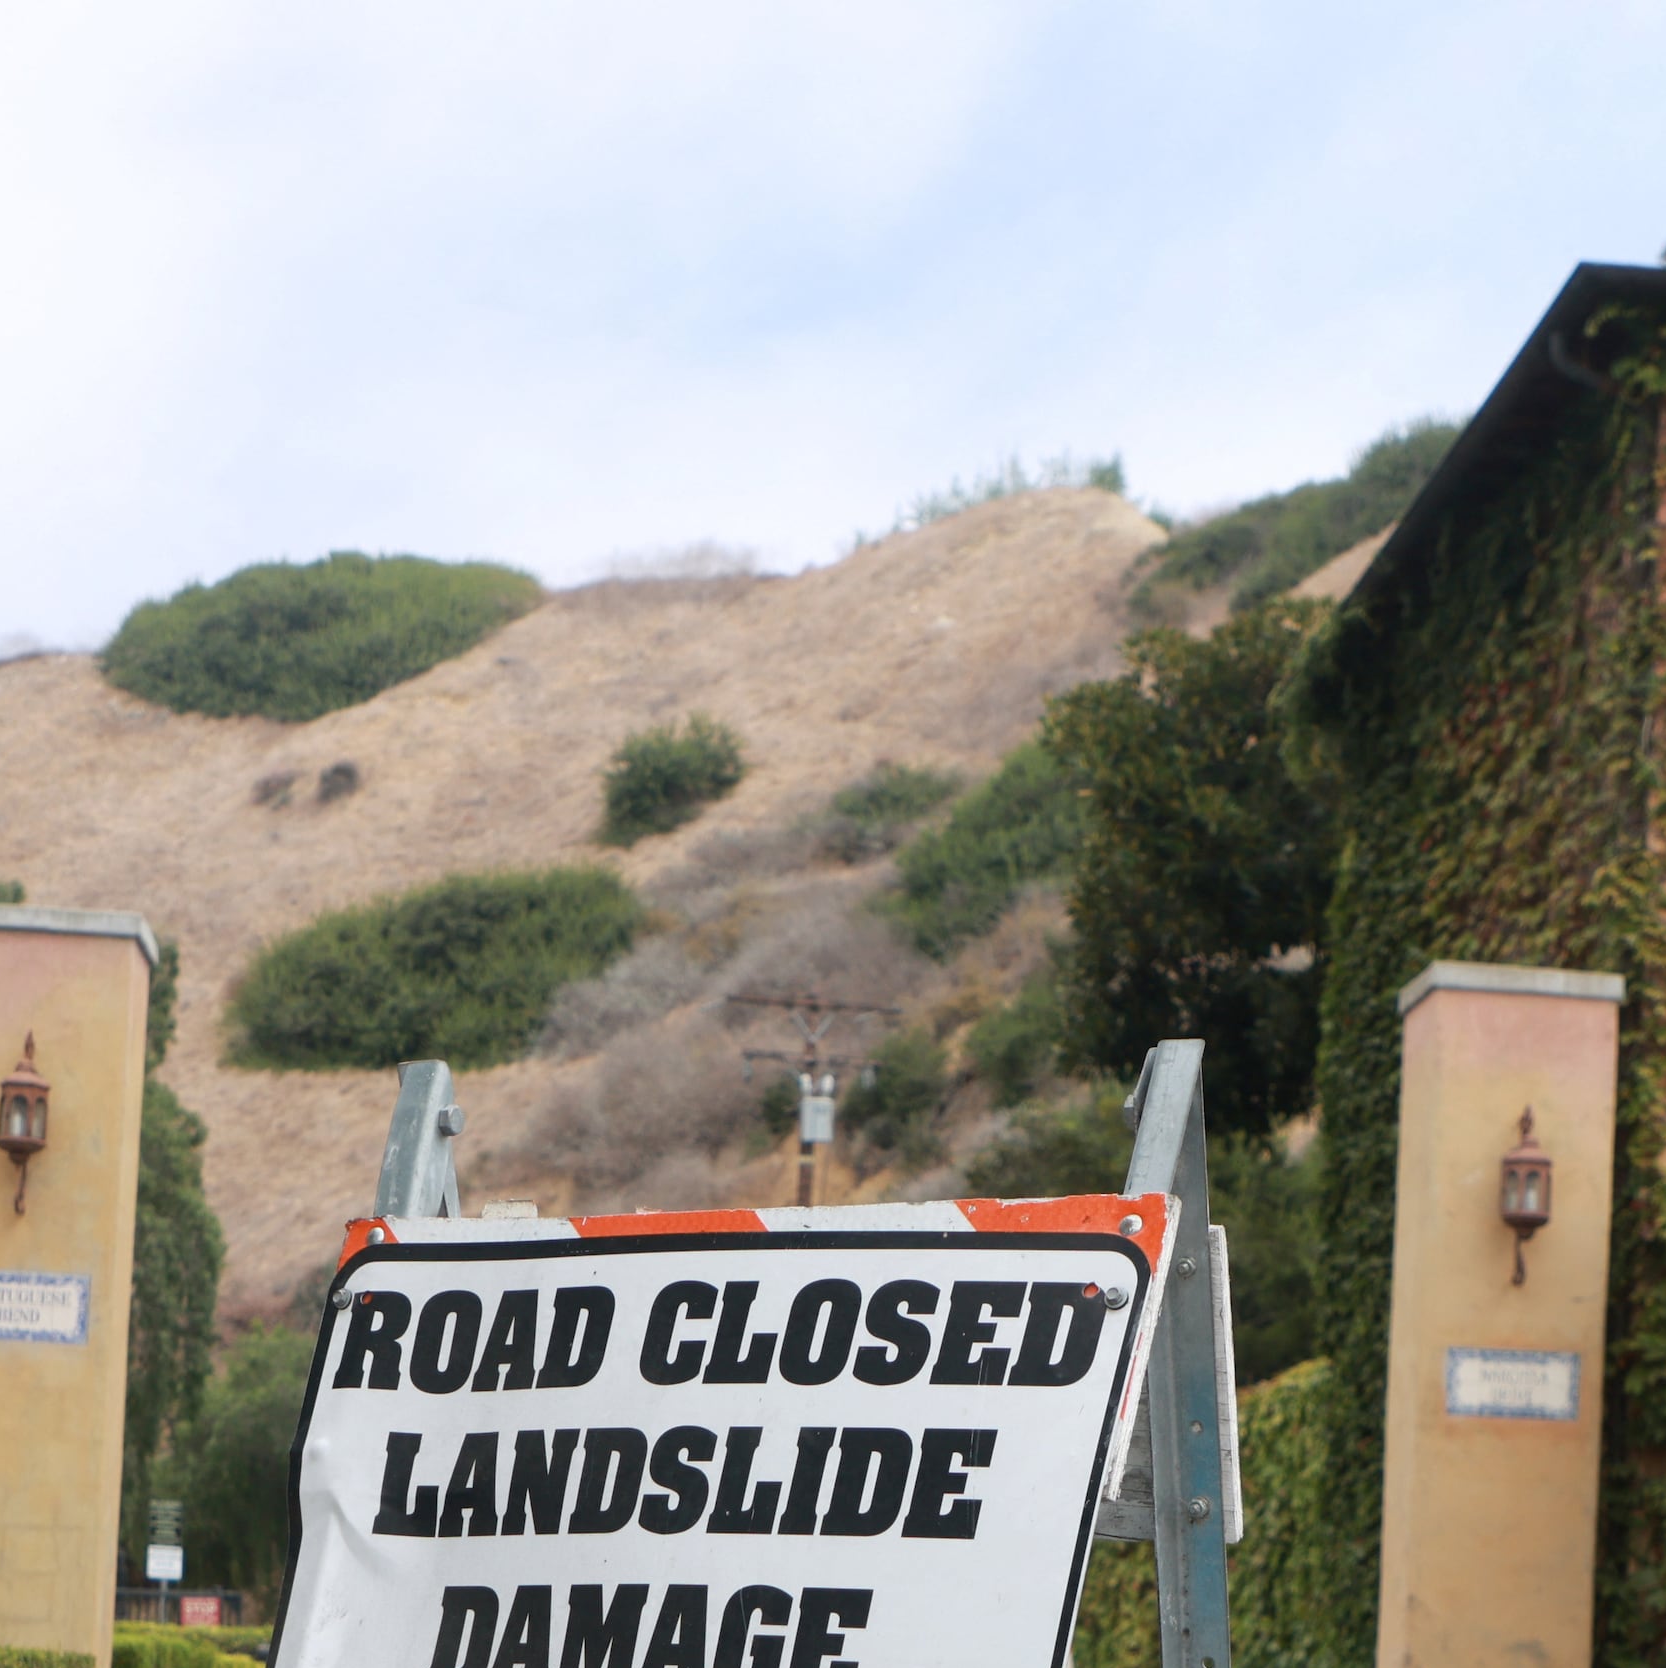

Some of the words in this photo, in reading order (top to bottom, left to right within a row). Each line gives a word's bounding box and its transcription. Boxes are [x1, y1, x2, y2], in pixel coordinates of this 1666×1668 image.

[333, 1286, 615, 1394] ROAD
[640, 1279, 1103, 1387] CLOSED
[372, 1426, 997, 1539] LANDSLIDE
